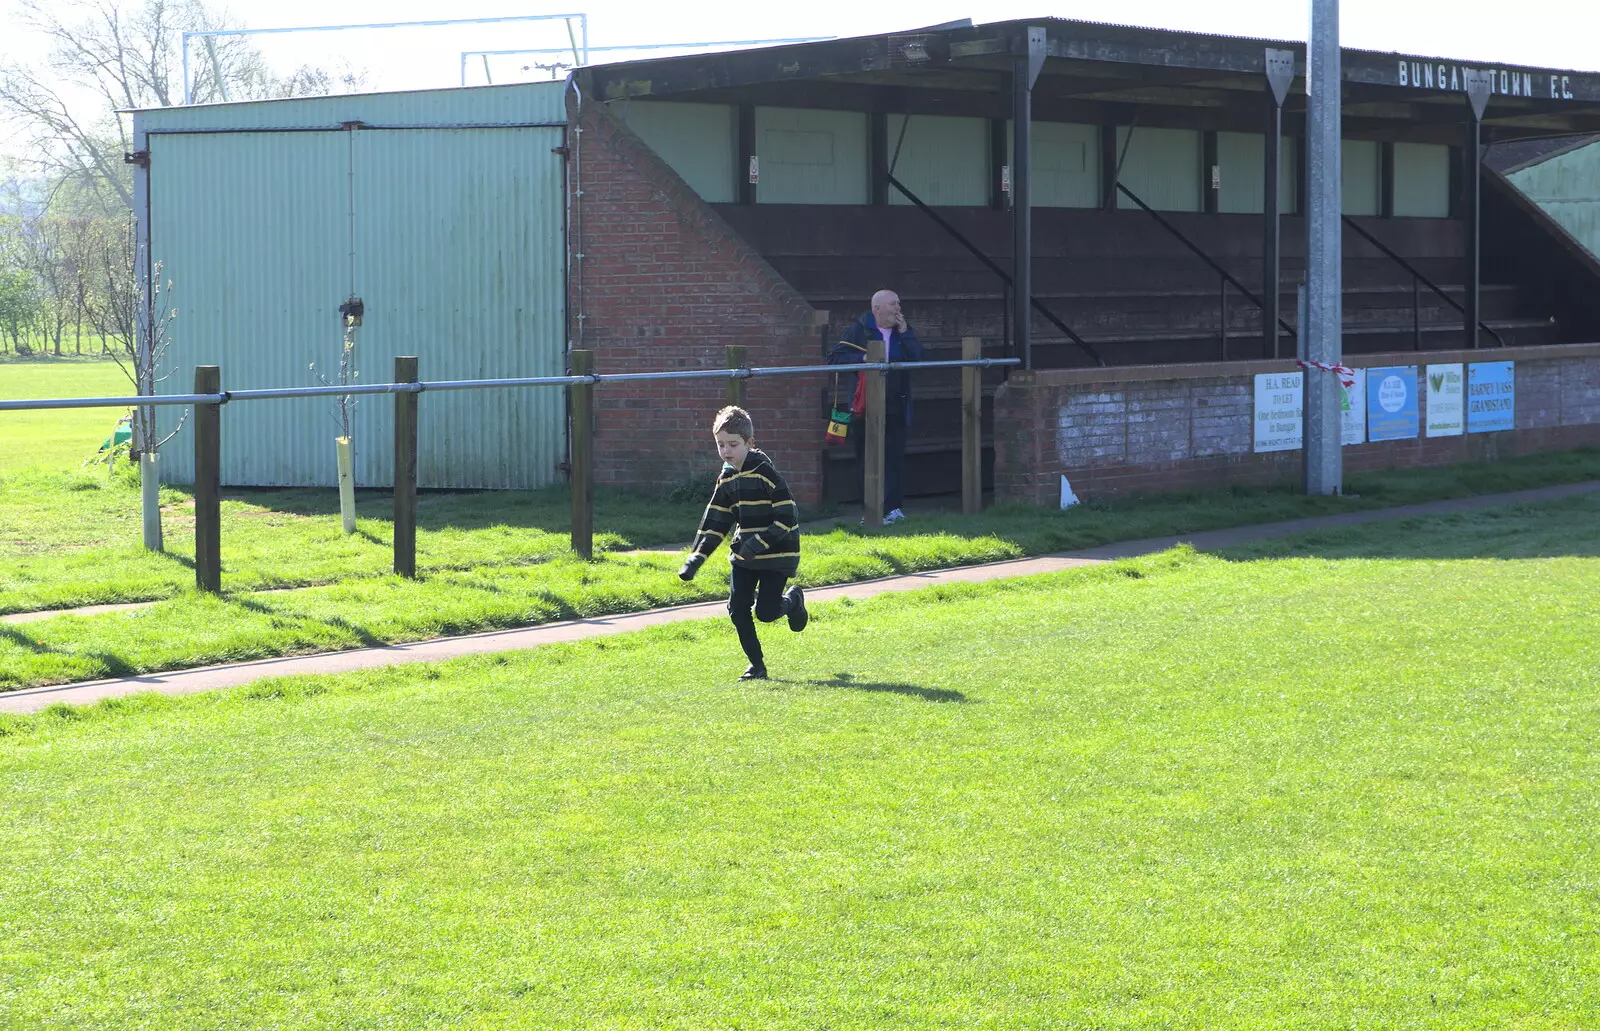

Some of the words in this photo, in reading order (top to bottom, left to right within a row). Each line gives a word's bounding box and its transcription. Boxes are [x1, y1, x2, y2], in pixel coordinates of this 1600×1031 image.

[1399, 61, 1468, 91] BUNGAY
[1489, 69, 1532, 97] TOWN
[1281, 377, 1300, 389] READ
[1272, 394, 1281, 405] TO
[1282, 393, 1293, 404] LET
[1470, 398, 1513, 413] GRANDSTAND
